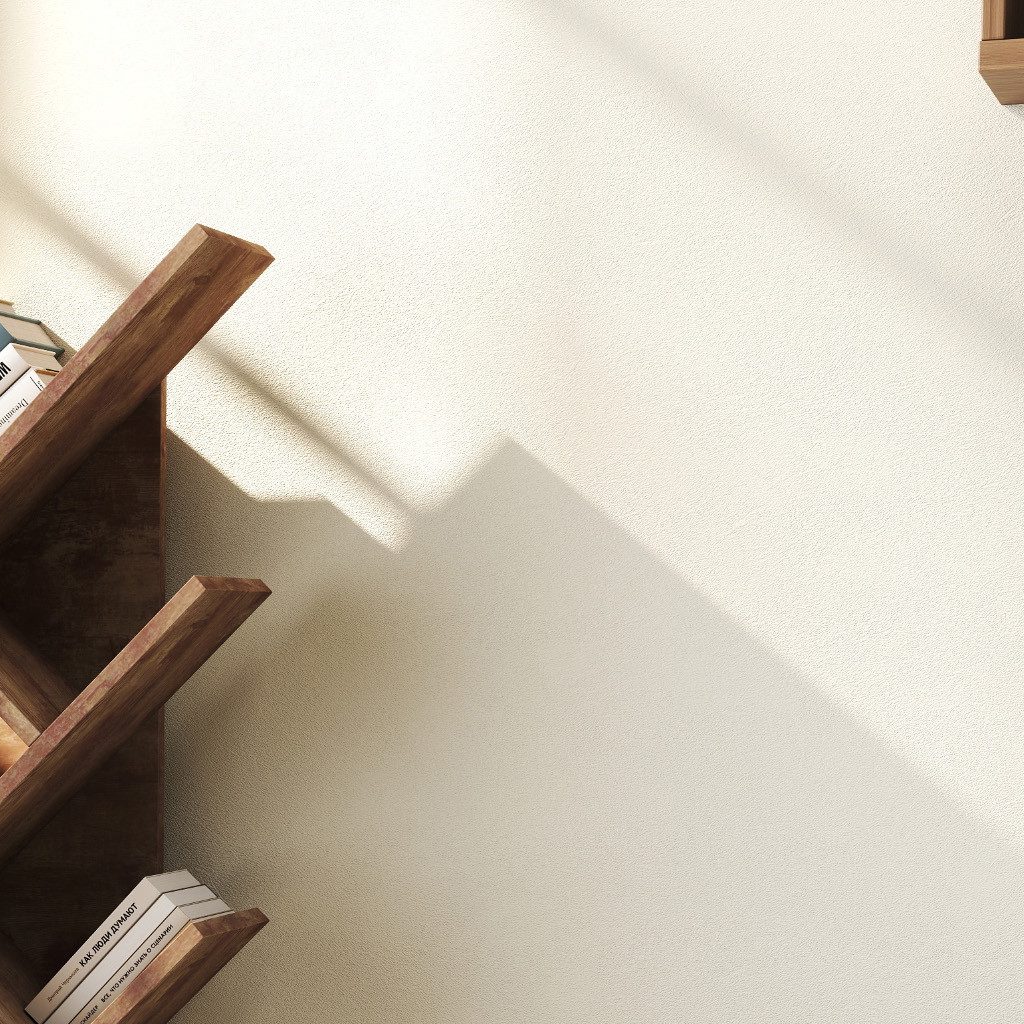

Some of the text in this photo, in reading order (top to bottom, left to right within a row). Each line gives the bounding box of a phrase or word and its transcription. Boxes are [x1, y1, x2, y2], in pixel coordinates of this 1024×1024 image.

[79, 902, 138, 967] КАК ЛЮДИ ДУМАЮТ
[110, 983, 120, 993] ЧТО
[118, 966, 135, 984] НУЖНО
[134, 952, 148, 968] ЗНАТЬ
[151, 924, 173, 949] СЦЕНАРИИ
